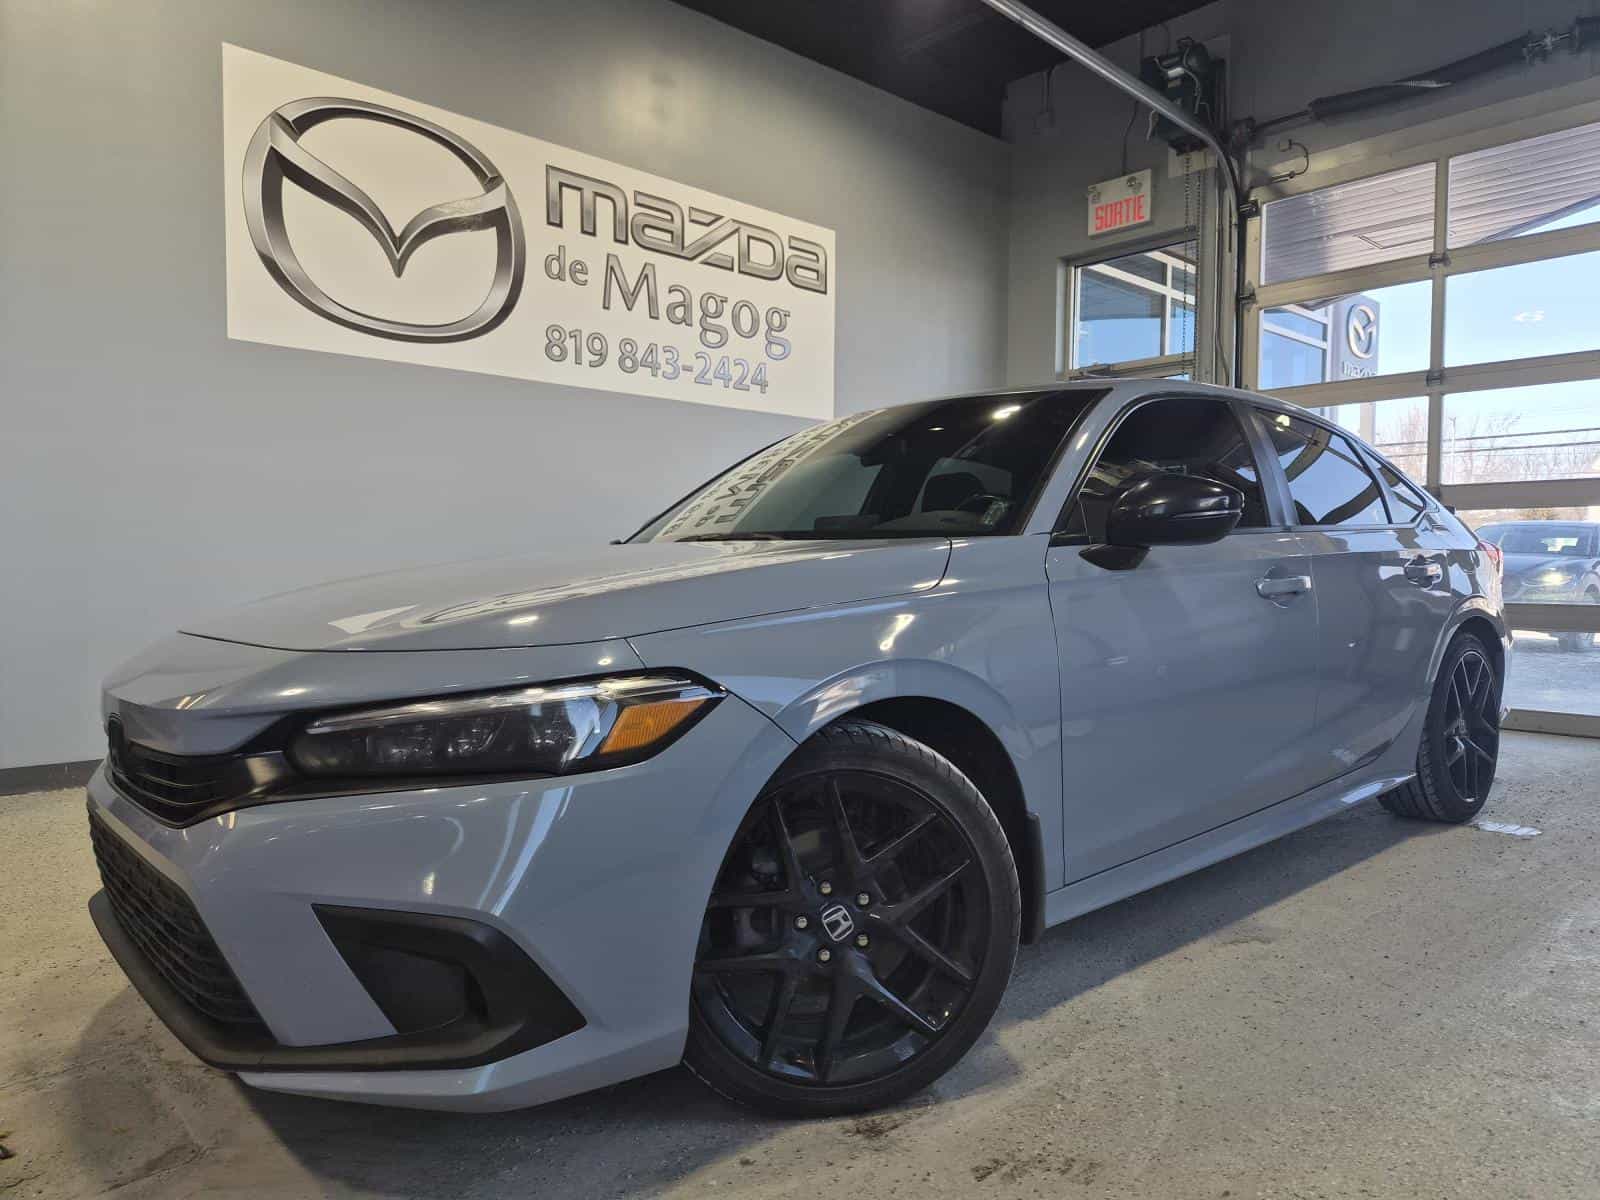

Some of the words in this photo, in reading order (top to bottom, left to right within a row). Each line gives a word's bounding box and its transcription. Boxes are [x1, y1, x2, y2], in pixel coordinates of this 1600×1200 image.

[1095, 193, 1146, 232] SORTIE
[544, 245, 589, 286] de
[602, 252, 792, 361] Magog
[544, 324, 609, 369] 819
[617, 337, 769, 394] 843-2424
